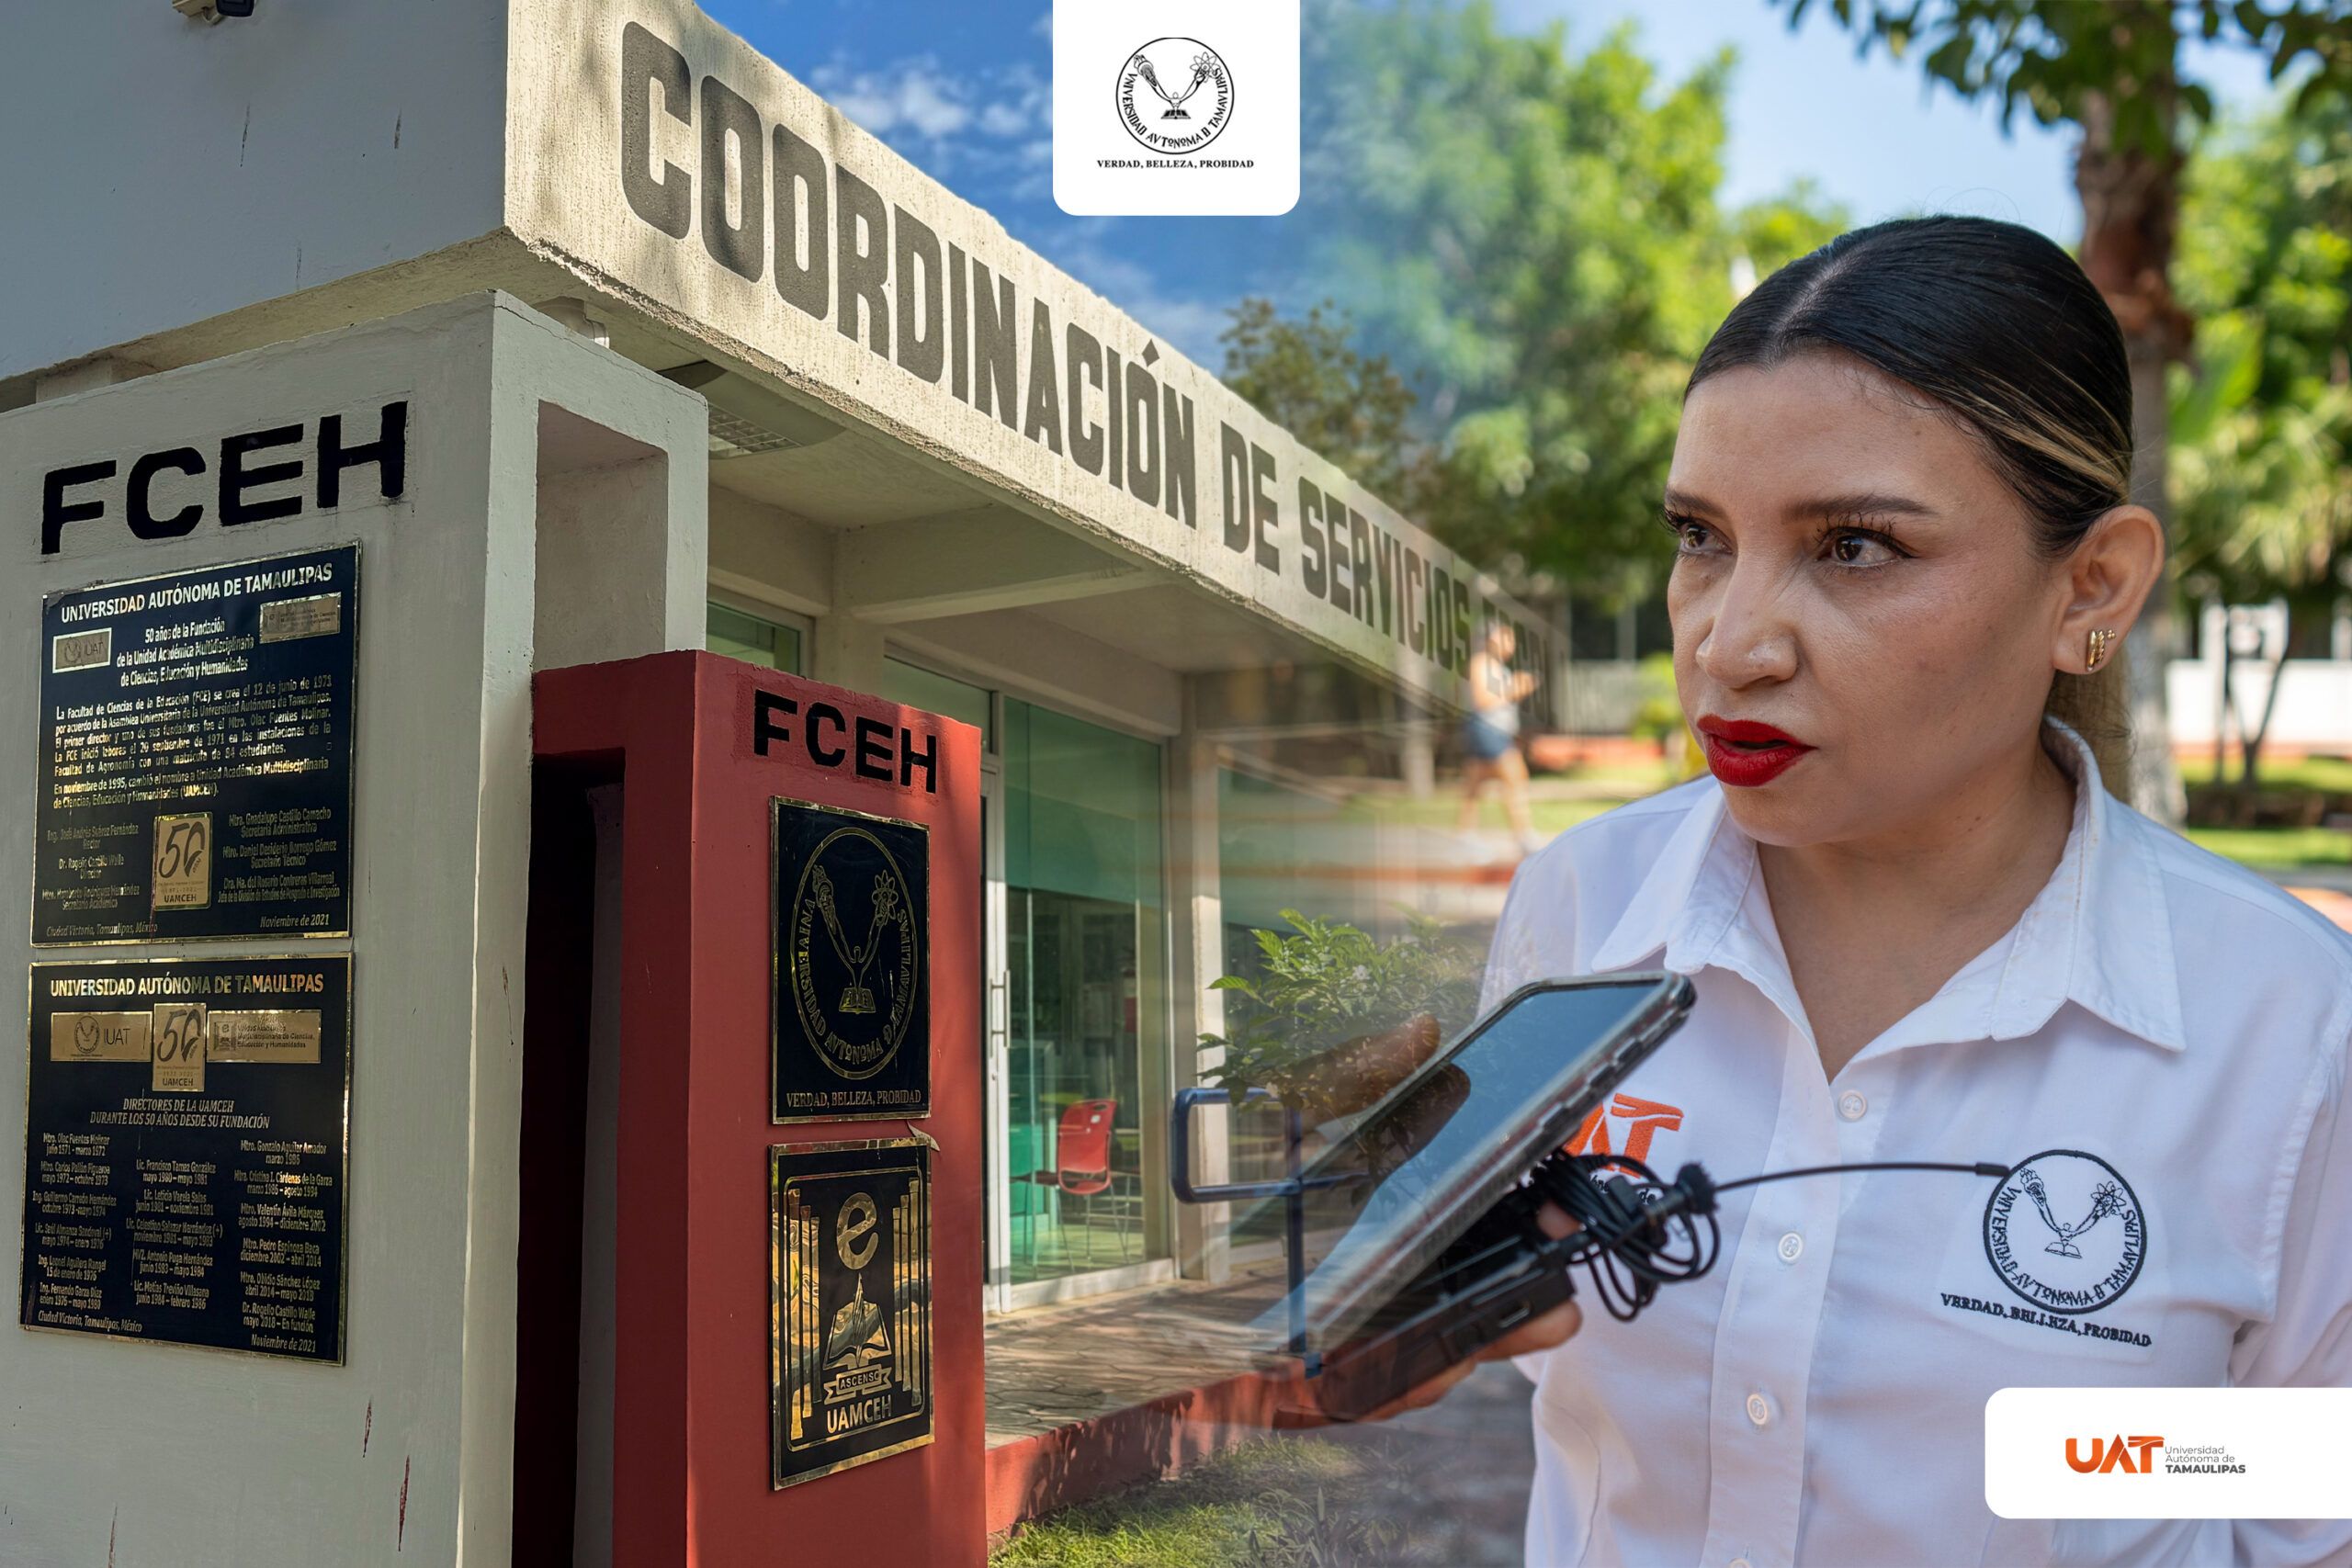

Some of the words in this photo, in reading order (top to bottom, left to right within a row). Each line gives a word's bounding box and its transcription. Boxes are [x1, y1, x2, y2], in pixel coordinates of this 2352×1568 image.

[622, 21, 1197, 530] COORDINACIÓN
[1221, 421, 1280, 576] DE
[1298, 476, 1470, 680] SERVICIOS
[41, 400, 408, 555] FCEH
[62, 594, 145, 623] UNIVERSIDAD
[148, 582, 220, 609] AUTÓNOMA
[224, 578, 241, 597] DE
[244, 563, 332, 593] TAMAULIPAS
[145, 628, 154, 643] 50
[155, 626, 171, 641] años
[172, 624, 181, 639] de
[182, 623, 189, 637] la
[190, 616, 225, 636] Fundación
[117, 652, 126, 668] de
[126, 651, 132, 666] la
[133, 648, 157, 665] Unidad
[158, 642, 194, 661] Académica
[120, 672, 129, 687] de
[130, 669, 158, 685] Ciencias,
[195, 666, 199, 681] y
[201, 656, 248, 676] Humanidades
[57, 706, 64, 720] La
[68, 705, 93, 718] Facultad
[96, 704, 104, 716] de
[107, 701, 132, 714] Ciencias
[136, 698, 143, 711] de
[147, 697, 153, 708] la
[213, 690, 222, 700] se
[300, 677, 310, 690] de
[67, 720, 91, 733] acuerdo
[93, 718, 100, 729] de
[108, 715, 139, 728] Asamblea
[87, 733, 111, 745] director
[754, 689, 936, 794] FCEH
[86, 762, 95, 773] de
[54, 784, 62, 795] En
[98, 779, 107, 790] de
[164, 894, 197, 903] UAMCEH
[260, 915, 299, 928] Noviembre
[300, 915, 310, 926] de
[311, 913, 329, 926] 2021
[51, 978, 135, 997] UNIVERSIDAD
[138, 971, 211, 995] AUTÓNOMA
[214, 976, 232, 993] DE
[235, 974, 323, 992] TAMAULIPAS
[163, 1077, 193, 1087] UAMCEH
[123, 1099, 173, 1111] DIRECTORES
[174, 1100, 186, 1111] DE
[187, 1100, 197, 1112] LA
[198, 1100, 234, 1113] UAMCEH
[786, 1091, 830, 1109] VERDAD,
[831, 1089, 875, 1107] BELLEZA,
[876, 1089, 921, 1104] PROBIDAD
[90, 1111, 128, 1125] DURANTE
[128, 1112, 143, 1125] LOS
[144, 1112, 155, 1125] 50
[156, 1111, 178, 1126] AÑOS
[179, 1113, 206, 1127] DESDE
[207, 1114, 219, 1128] SU
[220, 1113, 270, 1129] FUNDACIÓN
[1940, 1292, 2008, 1318] VERDAD,
[2084, 1323, 2152, 1347] PROBIDAD
[252, 1334, 288, 1349] Noviembre
[288, 1337, 297, 1349] de
[299, 1339, 316, 1352] 2021
[840, 1371, 879, 1389] ASCENSO
[827, 1393, 891, 1433] UAMCEH
